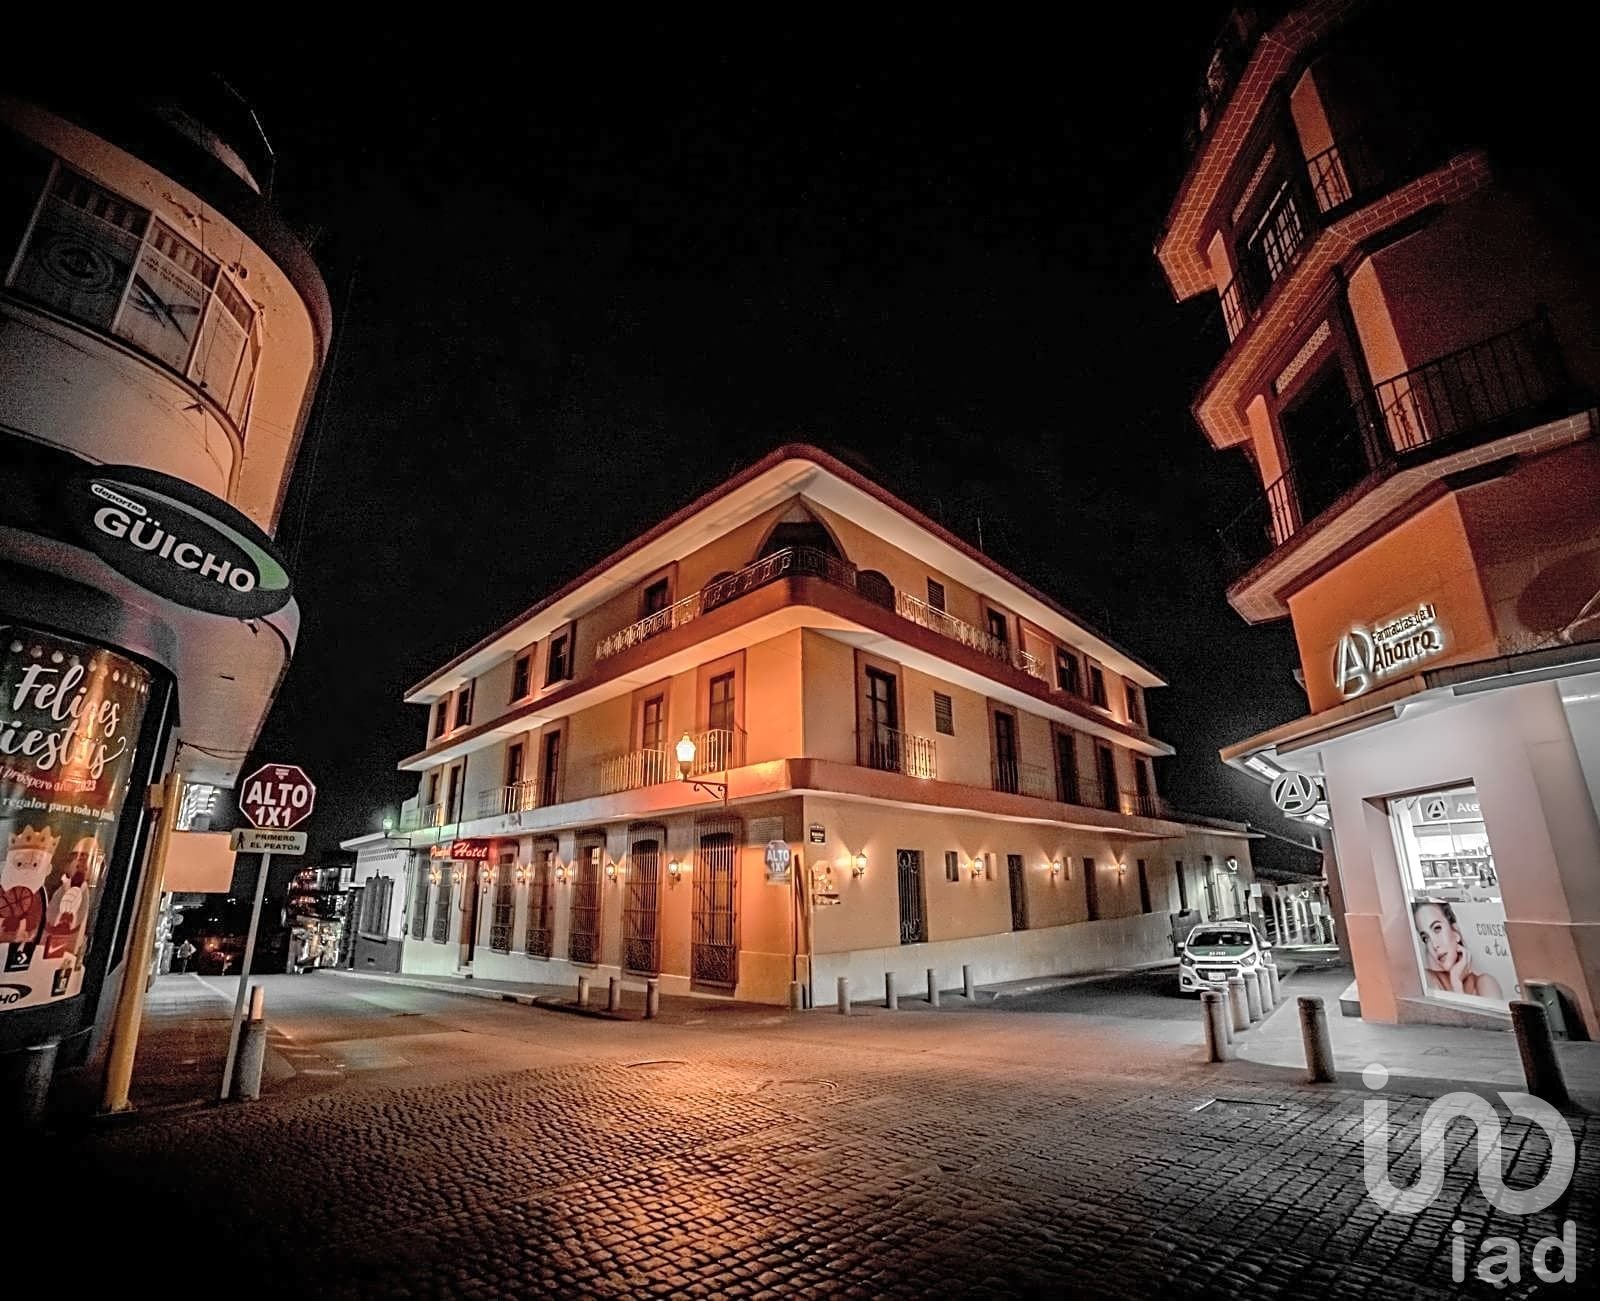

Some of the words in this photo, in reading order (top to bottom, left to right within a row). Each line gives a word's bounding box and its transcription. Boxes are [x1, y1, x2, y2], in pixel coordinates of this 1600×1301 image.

[93, 485, 145, 515] deportes
[94, 507, 256, 592] GÜICHO
[1371, 615, 1415, 644] Farmacias
[1372, 629, 1439, 673] Ahorro
[0, 719, 127, 780] iests
[2, 797, 47, 810] regalos
[48, 803, 72, 813] para
[245, 780, 308, 808] ALTO
[255, 805, 291, 827] 1X1
[453, 842, 488, 858] Hotel
[766, 849, 790, 862] ALTO
[771, 861, 785, 873] 1X1
[1485, 945, 1493, 956] a
